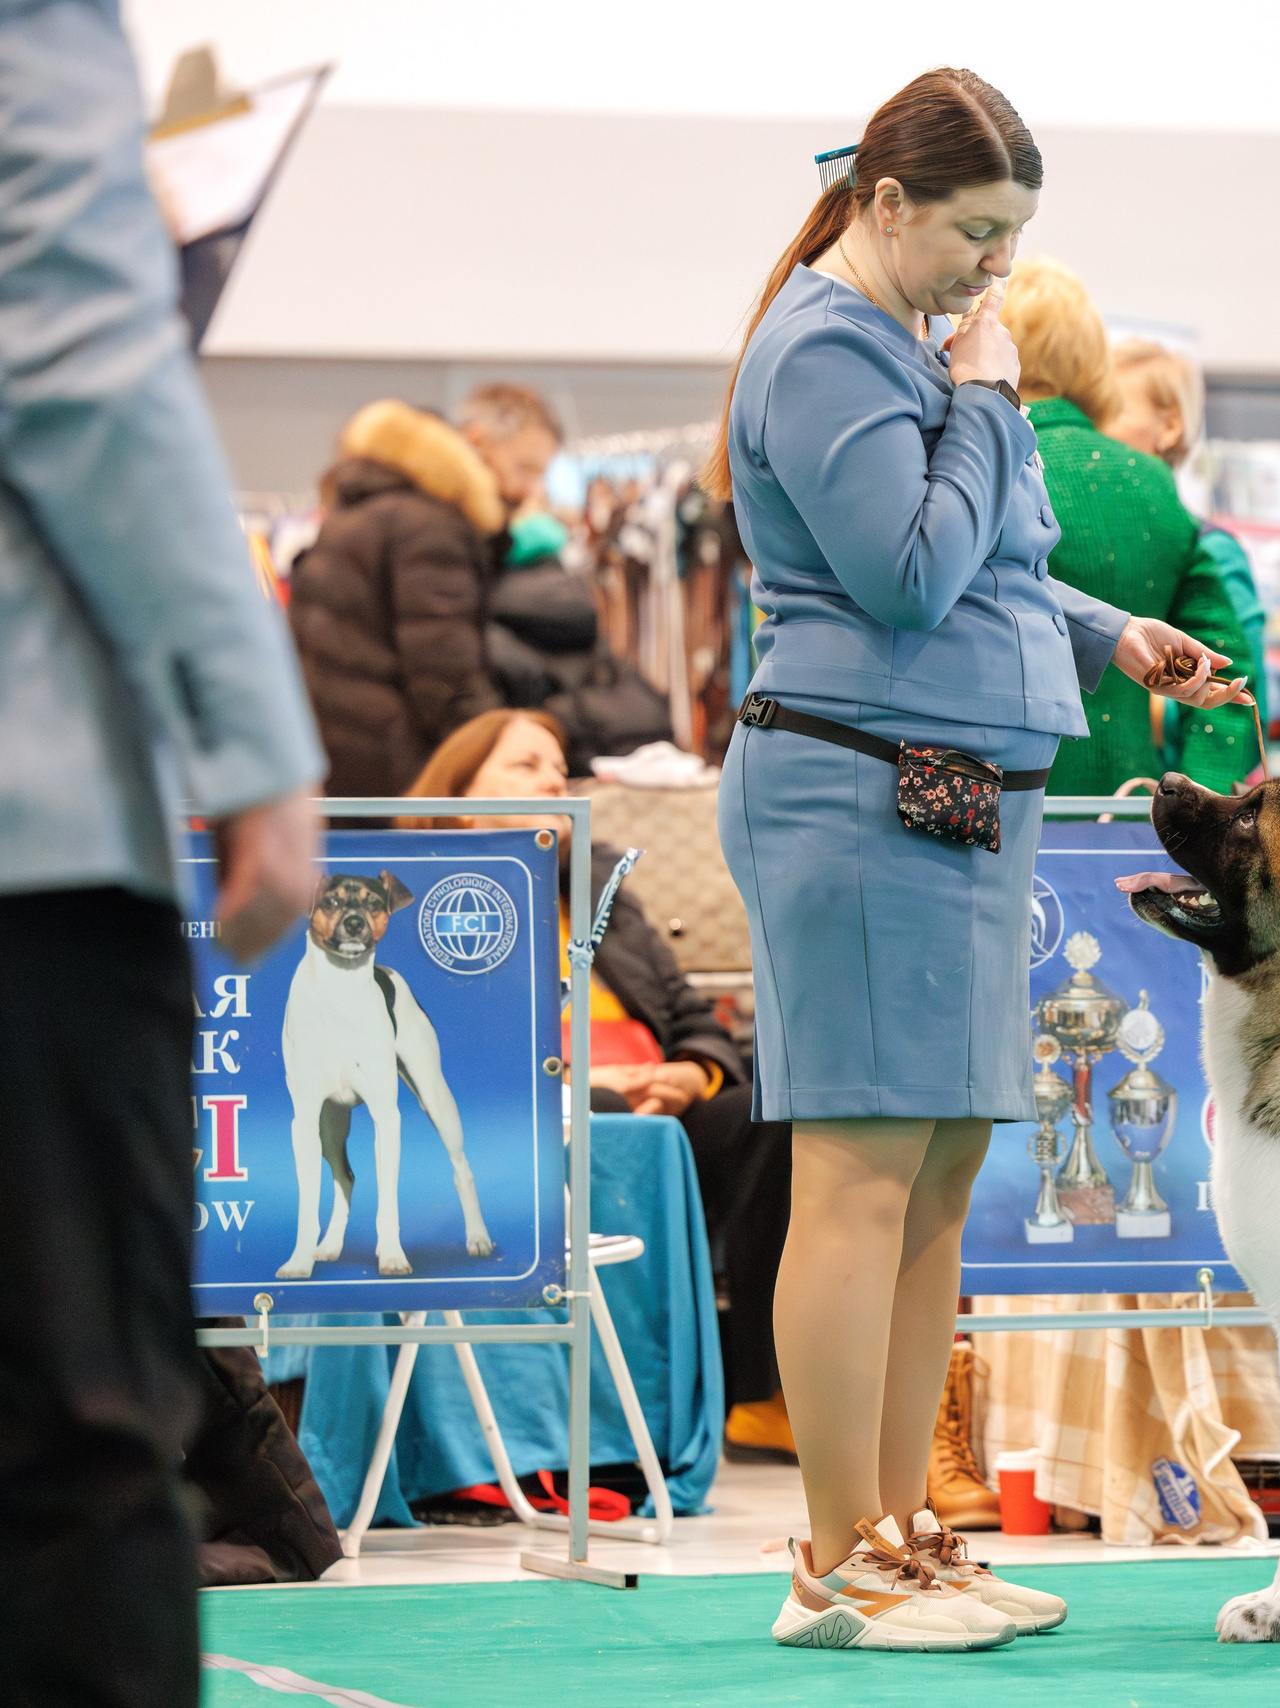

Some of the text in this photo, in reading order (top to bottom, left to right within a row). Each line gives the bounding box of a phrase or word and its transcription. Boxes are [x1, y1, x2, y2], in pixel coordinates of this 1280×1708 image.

[452, 915, 487, 932] FCI
[191, 1030, 241, 1074] К
[859, 1523, 877, 1541] FILA
